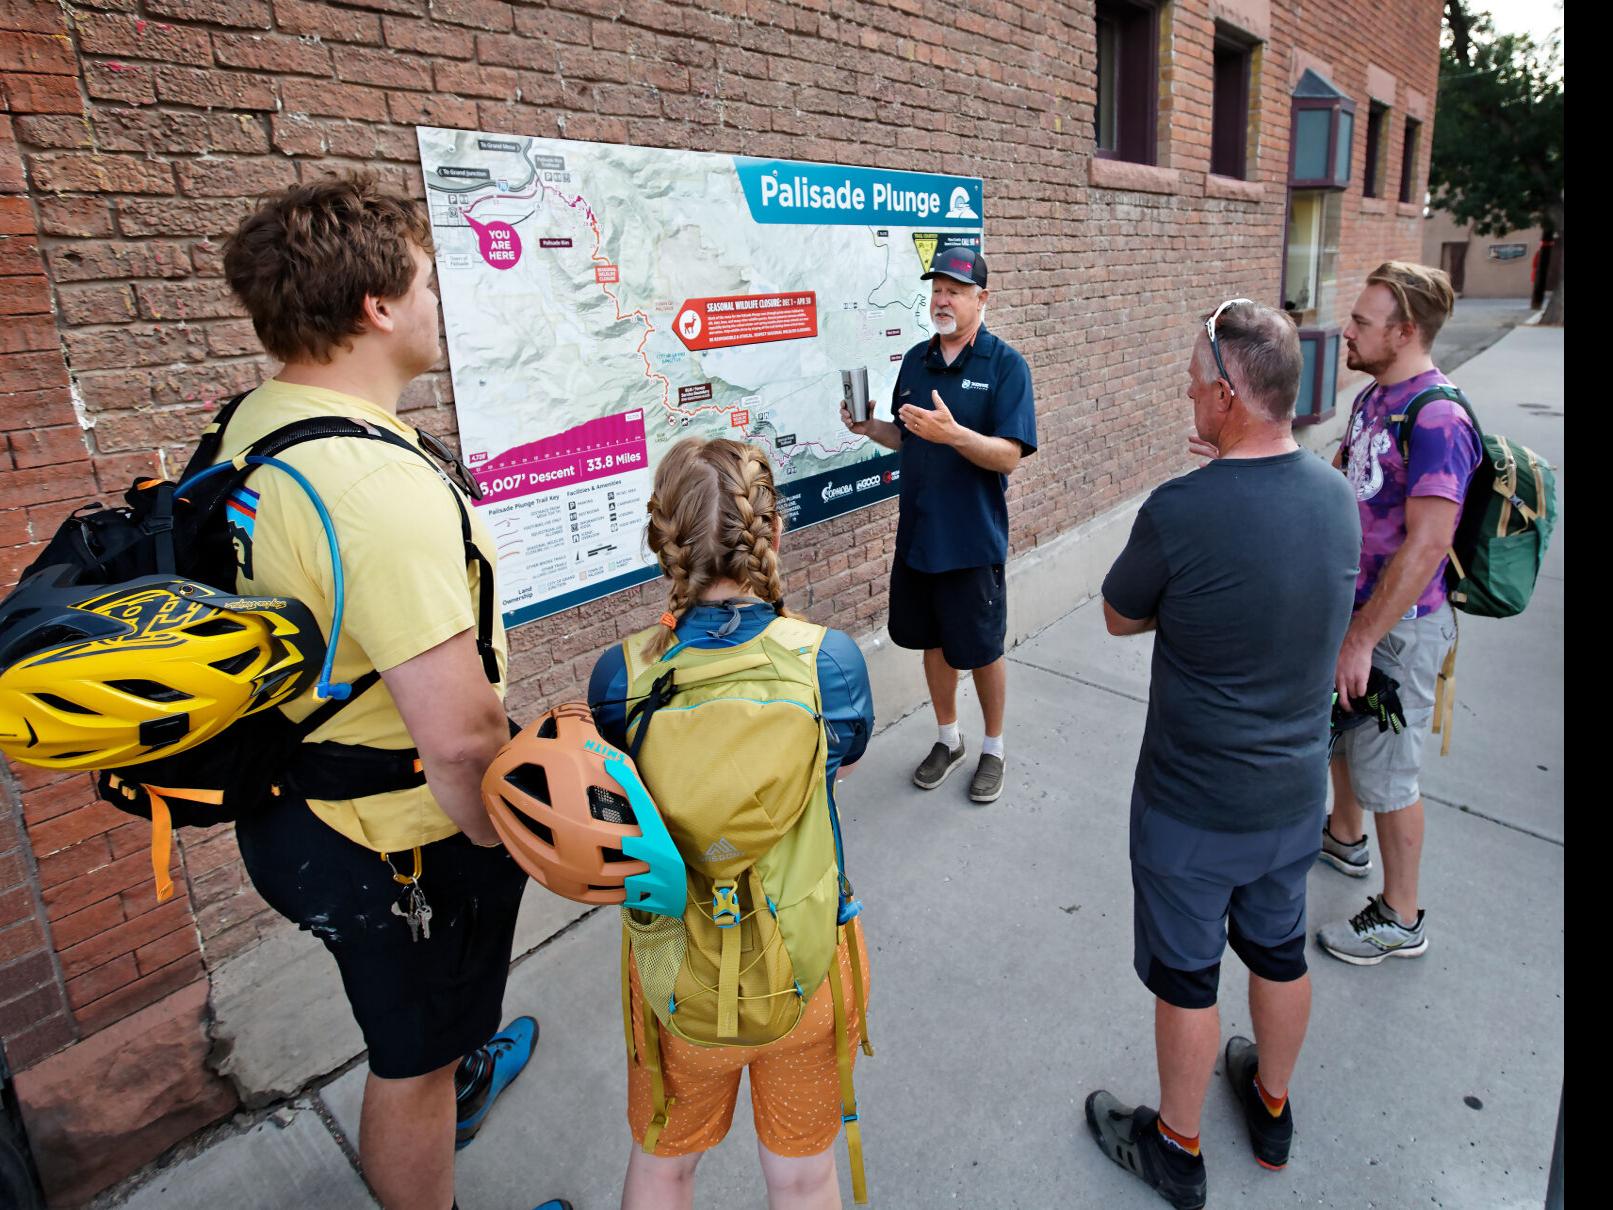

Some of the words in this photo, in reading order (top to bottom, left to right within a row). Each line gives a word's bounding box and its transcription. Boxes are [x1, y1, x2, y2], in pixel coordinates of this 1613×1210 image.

[761, 175, 865, 210] Palisade
[872, 183, 940, 217] Plunge
[488, 230, 510, 240] YOU
[490, 240, 512, 250] ARE
[489, 251, 515, 260] HERE
[707, 302, 734, 312] SEASONAL
[735, 300, 758, 310] WILDLIFE
[759, 298, 782, 308] CLOSURE:
[529, 464, 575, 485] Descent
[586, 455, 613, 472] 33.8
[616, 452, 641, 466] Miles
[567, 487, 590, 496] Facilities
[596, 480, 622, 489] Amenities
[488, 505, 513, 515] Palisade
[515, 501, 534, 510] Plunge
[536, 496, 548, 504] Trail
[518, 586, 532, 595] Land
[502, 592, 533, 606] Ownership
